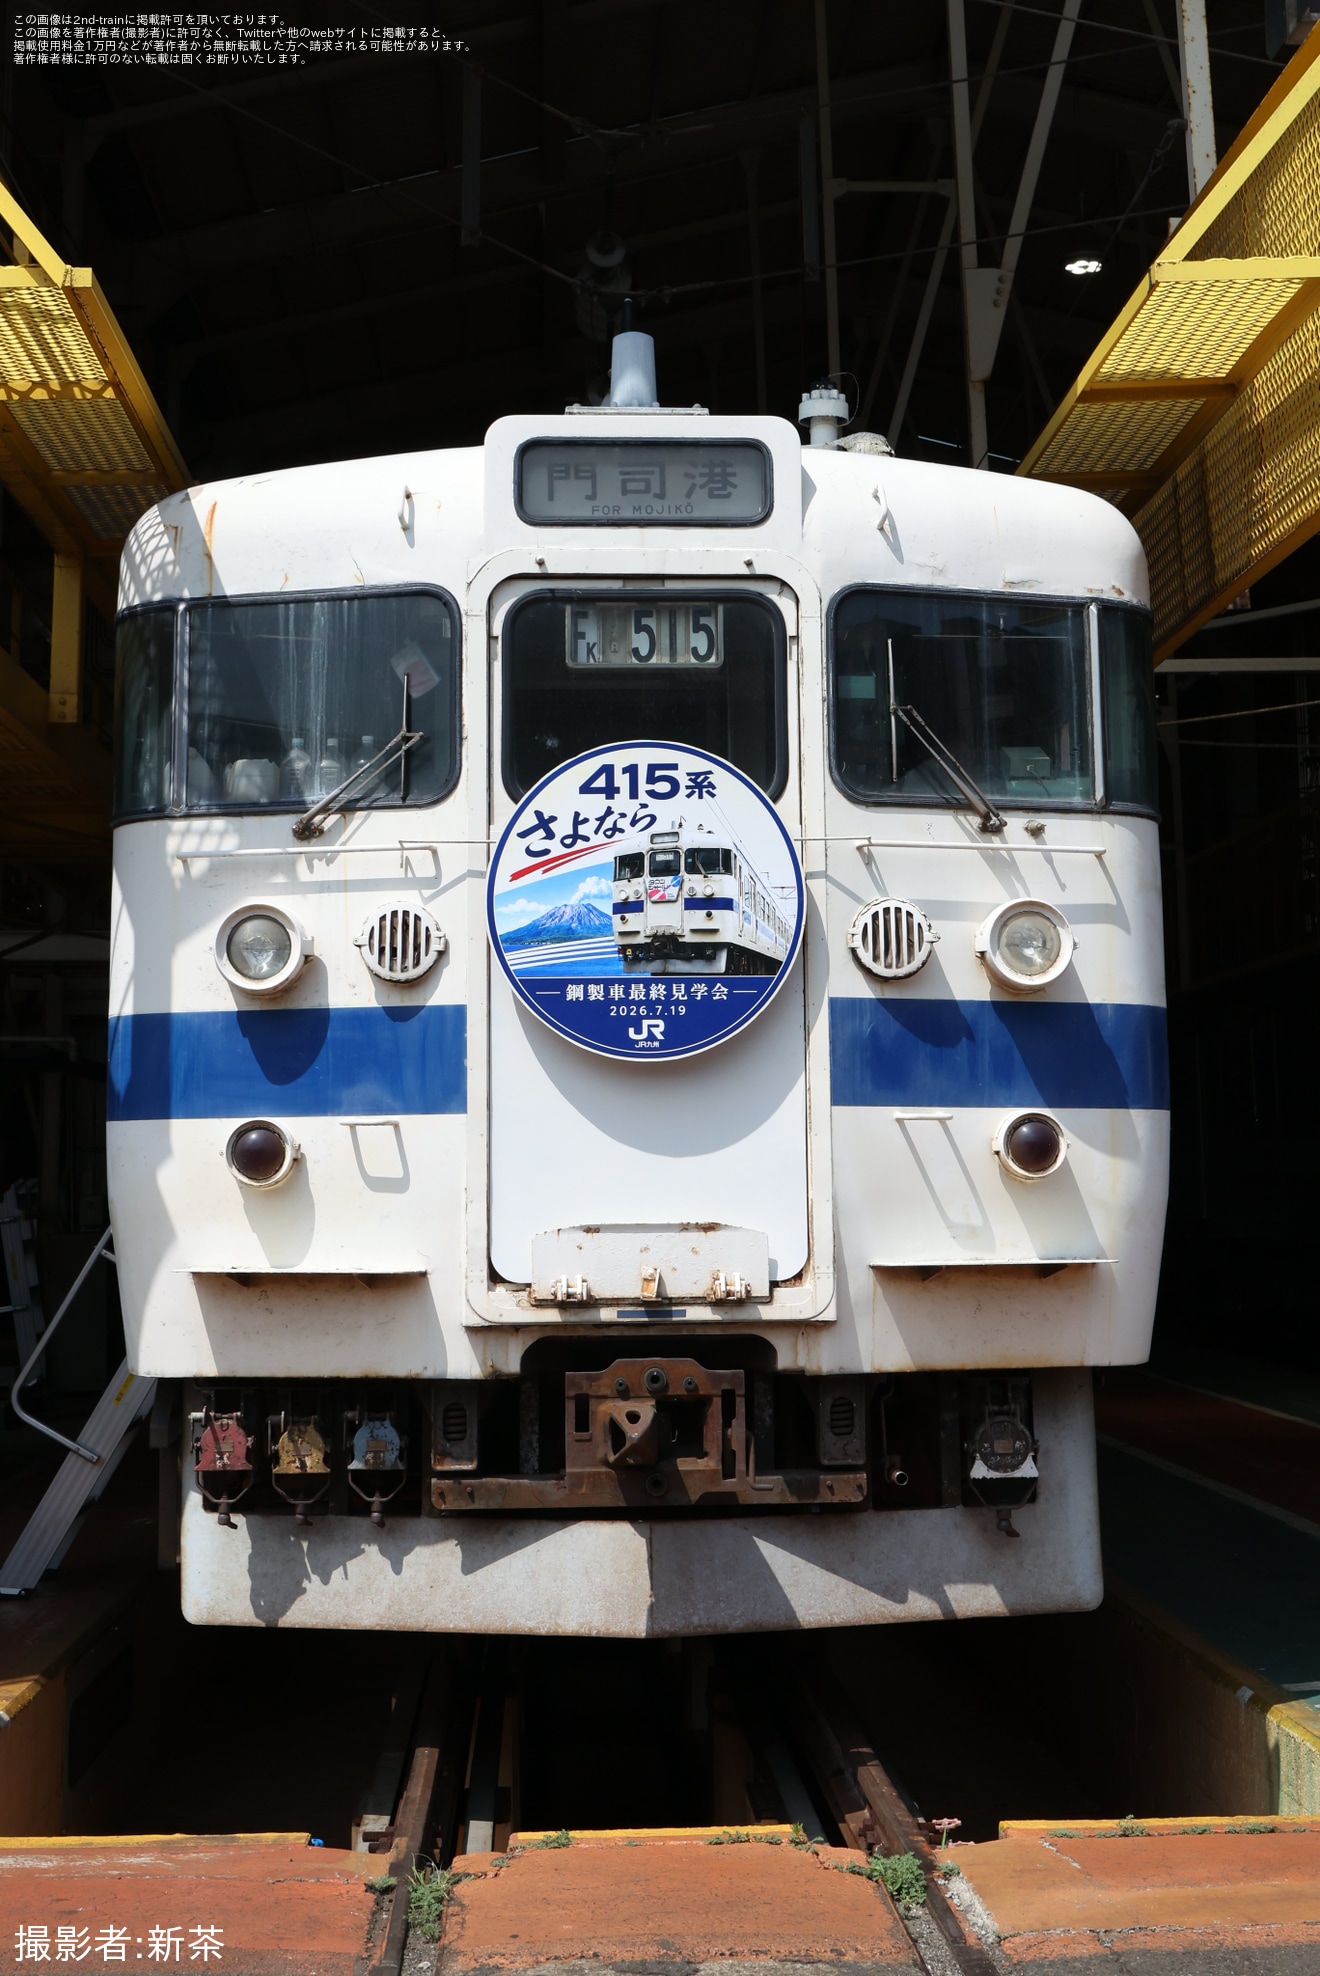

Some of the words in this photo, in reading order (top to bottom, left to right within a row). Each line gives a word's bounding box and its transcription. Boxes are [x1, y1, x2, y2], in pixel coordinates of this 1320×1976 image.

[547, 459, 738, 502] 門司港
[591, 504, 621, 516] FOR
[578, 763, 717, 800] 415系
[516, 803, 657, 858] さよなら
[565, 983, 729, 1002] 鋼製車最終見学会
[609, 1005, 687, 1016] 2026.7.19
[628, 1019, 665, 1040] JR
